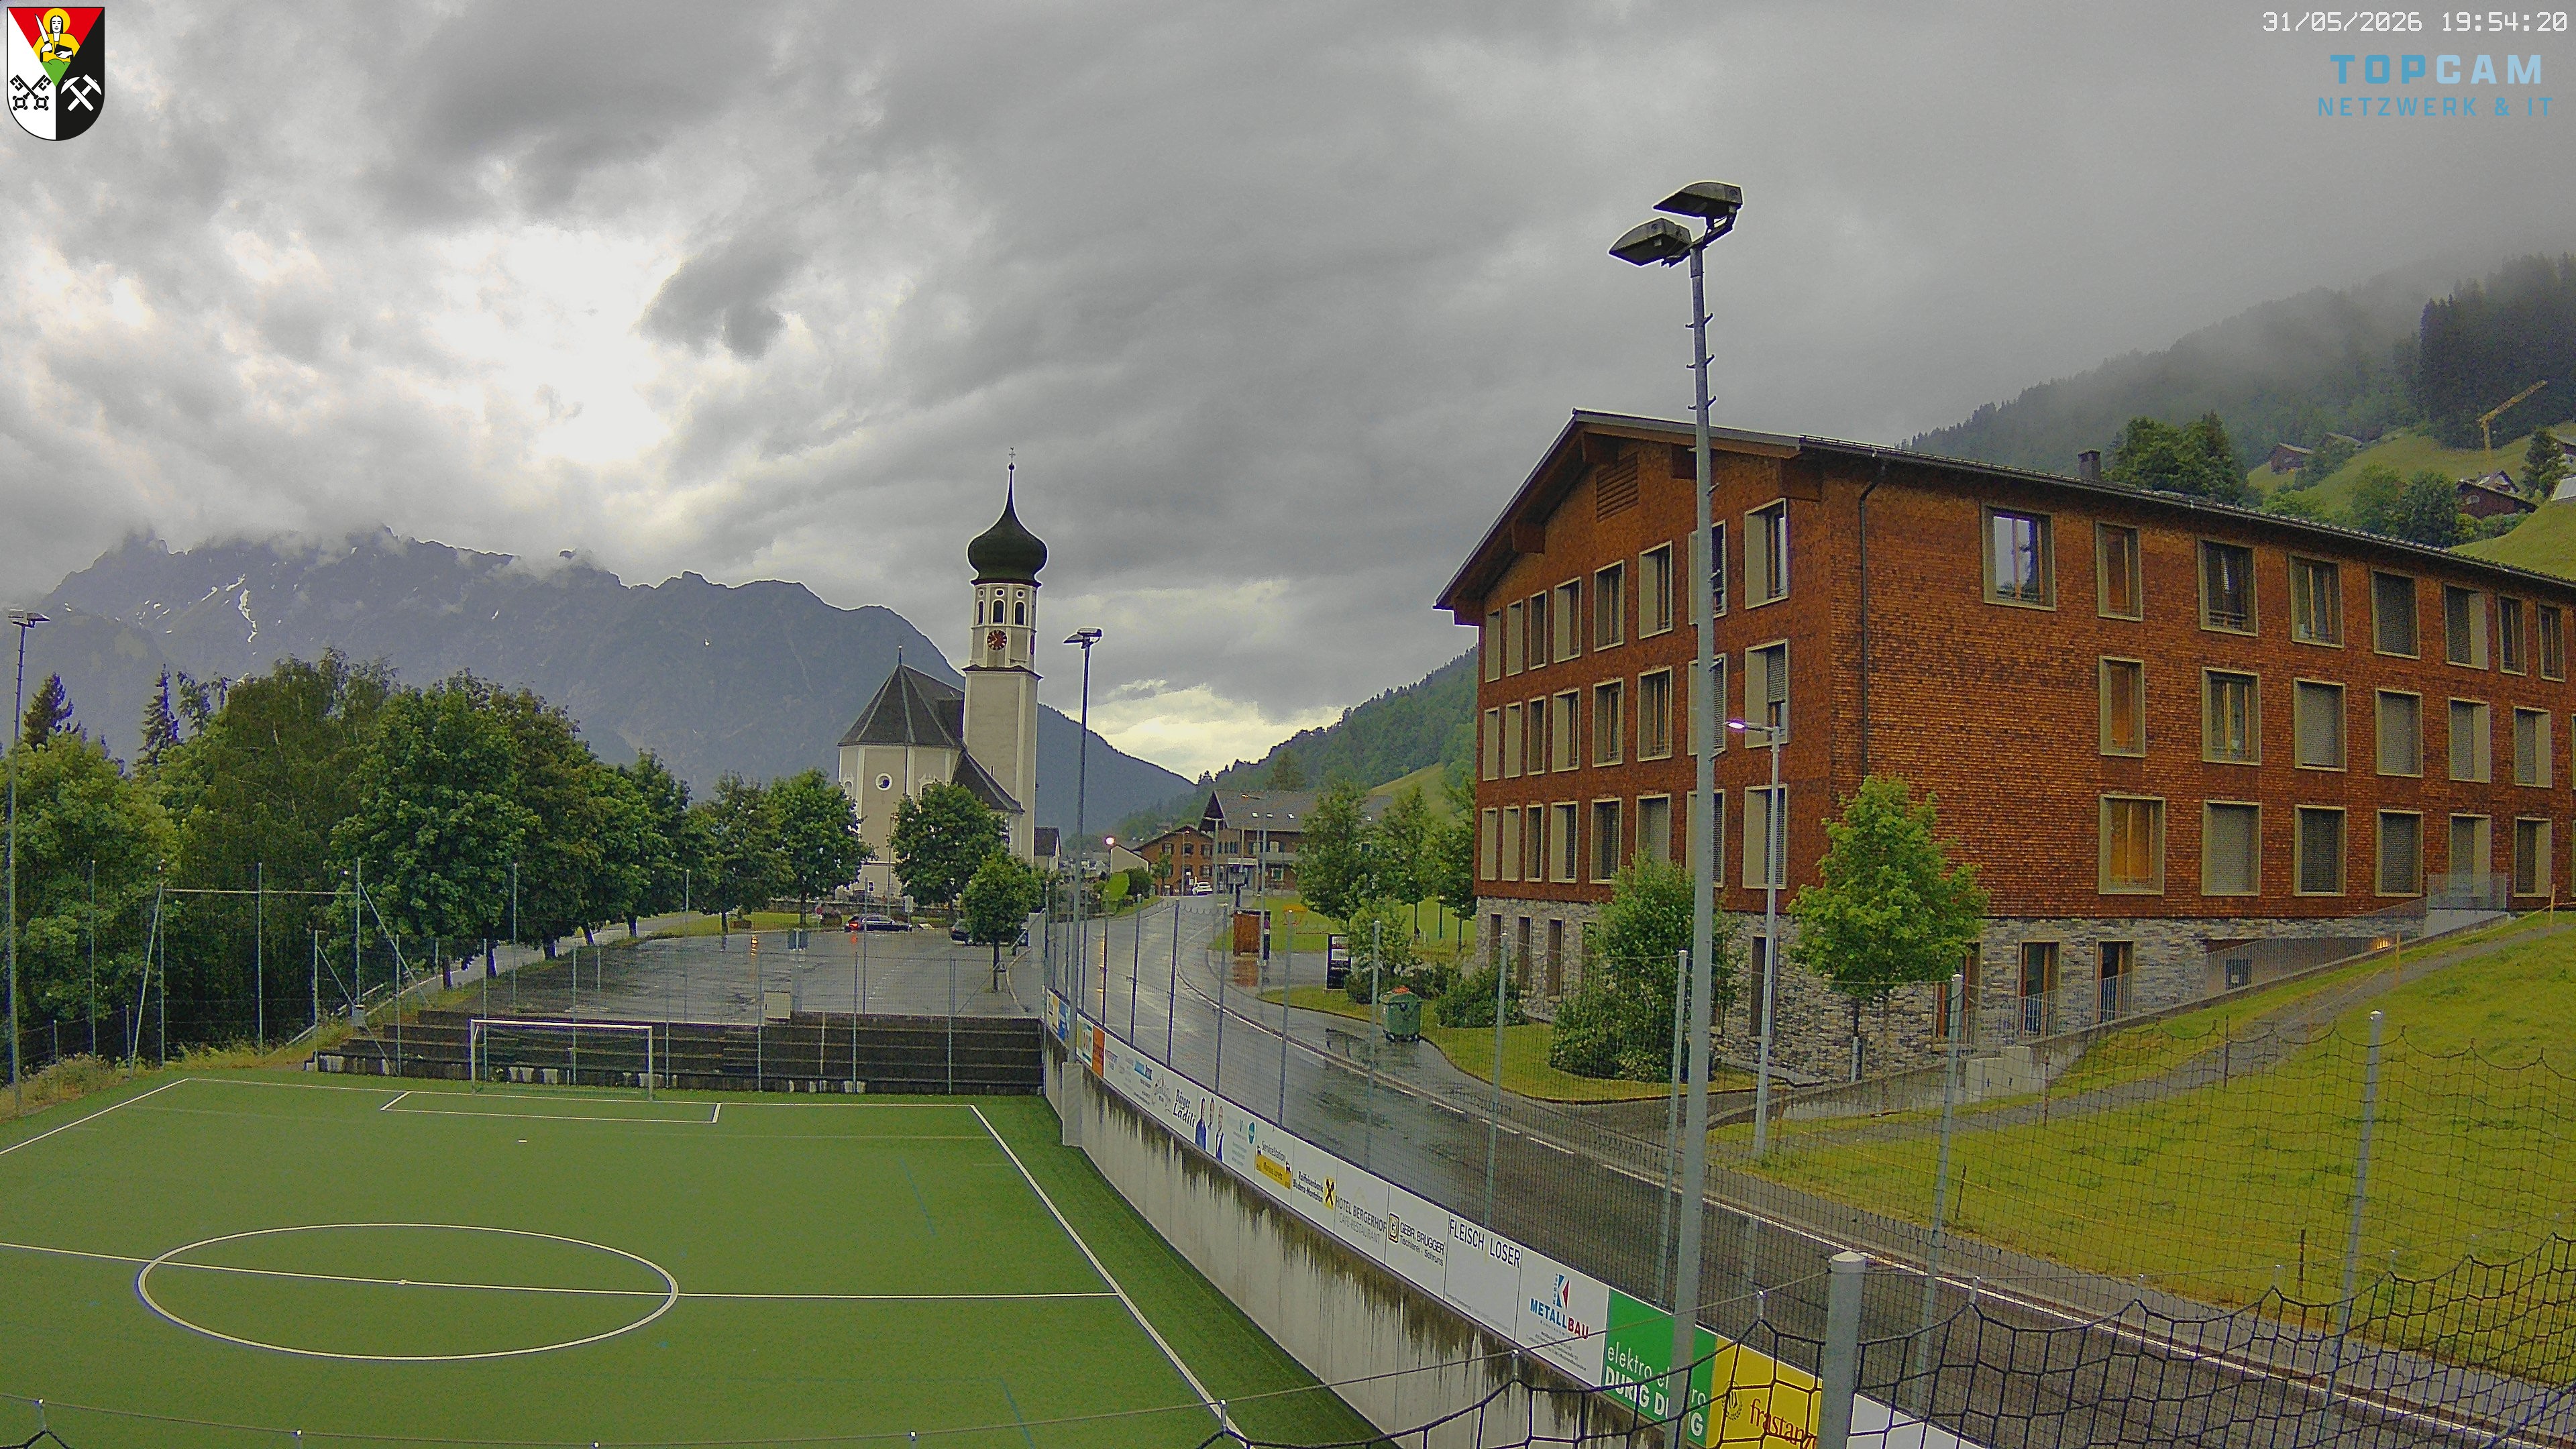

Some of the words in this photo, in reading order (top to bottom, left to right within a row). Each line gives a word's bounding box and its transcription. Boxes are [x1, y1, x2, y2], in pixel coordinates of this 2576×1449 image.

[1336, 1195, 1352, 1215] HOTEL
[1353, 1204, 1387, 1233] BERGERHOF
[1449, 1218, 1485, 1251] FLEISCH
[1489, 1238, 1521, 1269] LOSER
[1529, 1298, 1589, 1340] METALLBAU
[1607, 1341, 1652, 1380] elektro
